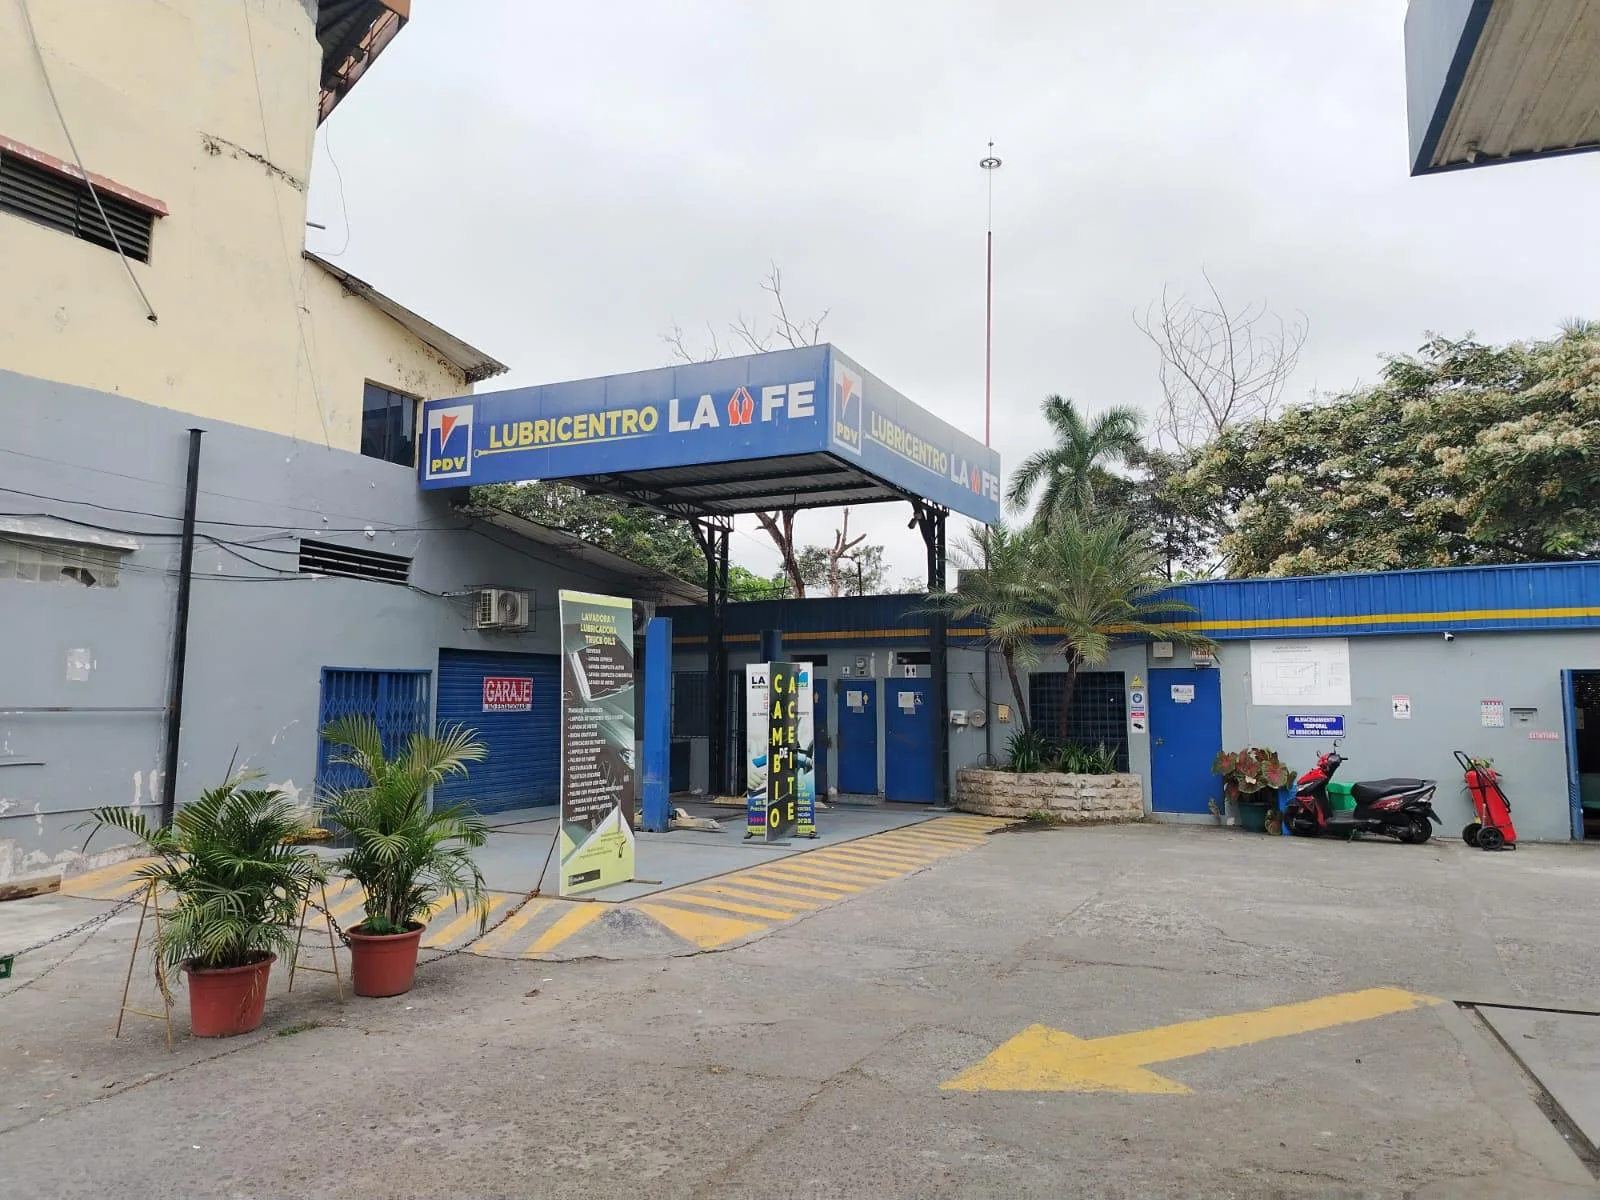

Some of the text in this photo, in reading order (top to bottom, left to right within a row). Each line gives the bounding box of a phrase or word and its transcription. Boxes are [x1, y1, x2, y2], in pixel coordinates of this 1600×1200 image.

[489, 380, 816, 449] LUBRICENTRO LA FE
[836, 421, 859, 445] PDV
[431, 456, 466, 473] PDV
[871, 410, 1000, 503] LUBRICENTRO LA FE
[581, 611, 610, 623] LAVADORA
[580, 622, 617, 635] LUBRICADORA
[486, 680, 530, 702] GARAJE
[752, 676, 765, 684] LA
[769, 673, 783, 829] CAMBIO
[779, 747, 789, 759] DE
[787, 676, 796, 821] ACEITE
